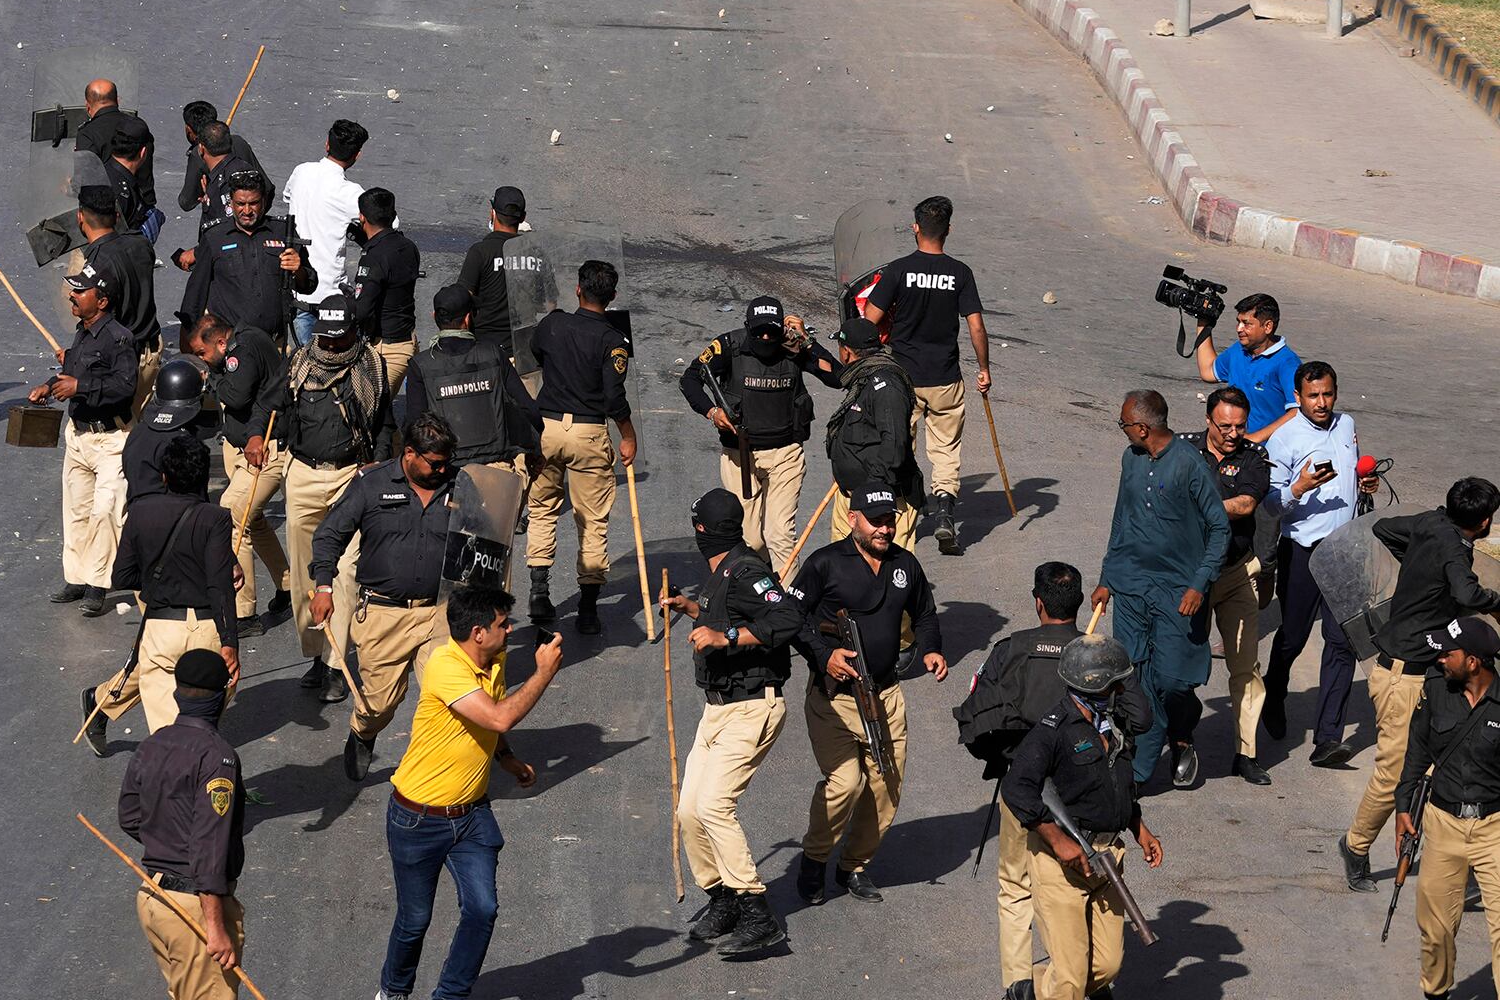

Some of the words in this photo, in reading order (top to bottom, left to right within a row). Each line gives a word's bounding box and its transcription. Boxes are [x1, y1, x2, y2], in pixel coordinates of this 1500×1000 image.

[494, 256, 543, 272] POLICE
[906, 272, 955, 290] POLICE
[319, 310, 345, 321] POLICE
[753, 305, 778, 316] POLICE
[866, 491, 894, 504] POLICE
[1036, 644, 1062, 654] SINDH
[1487, 721, 1500, 729] POLI
